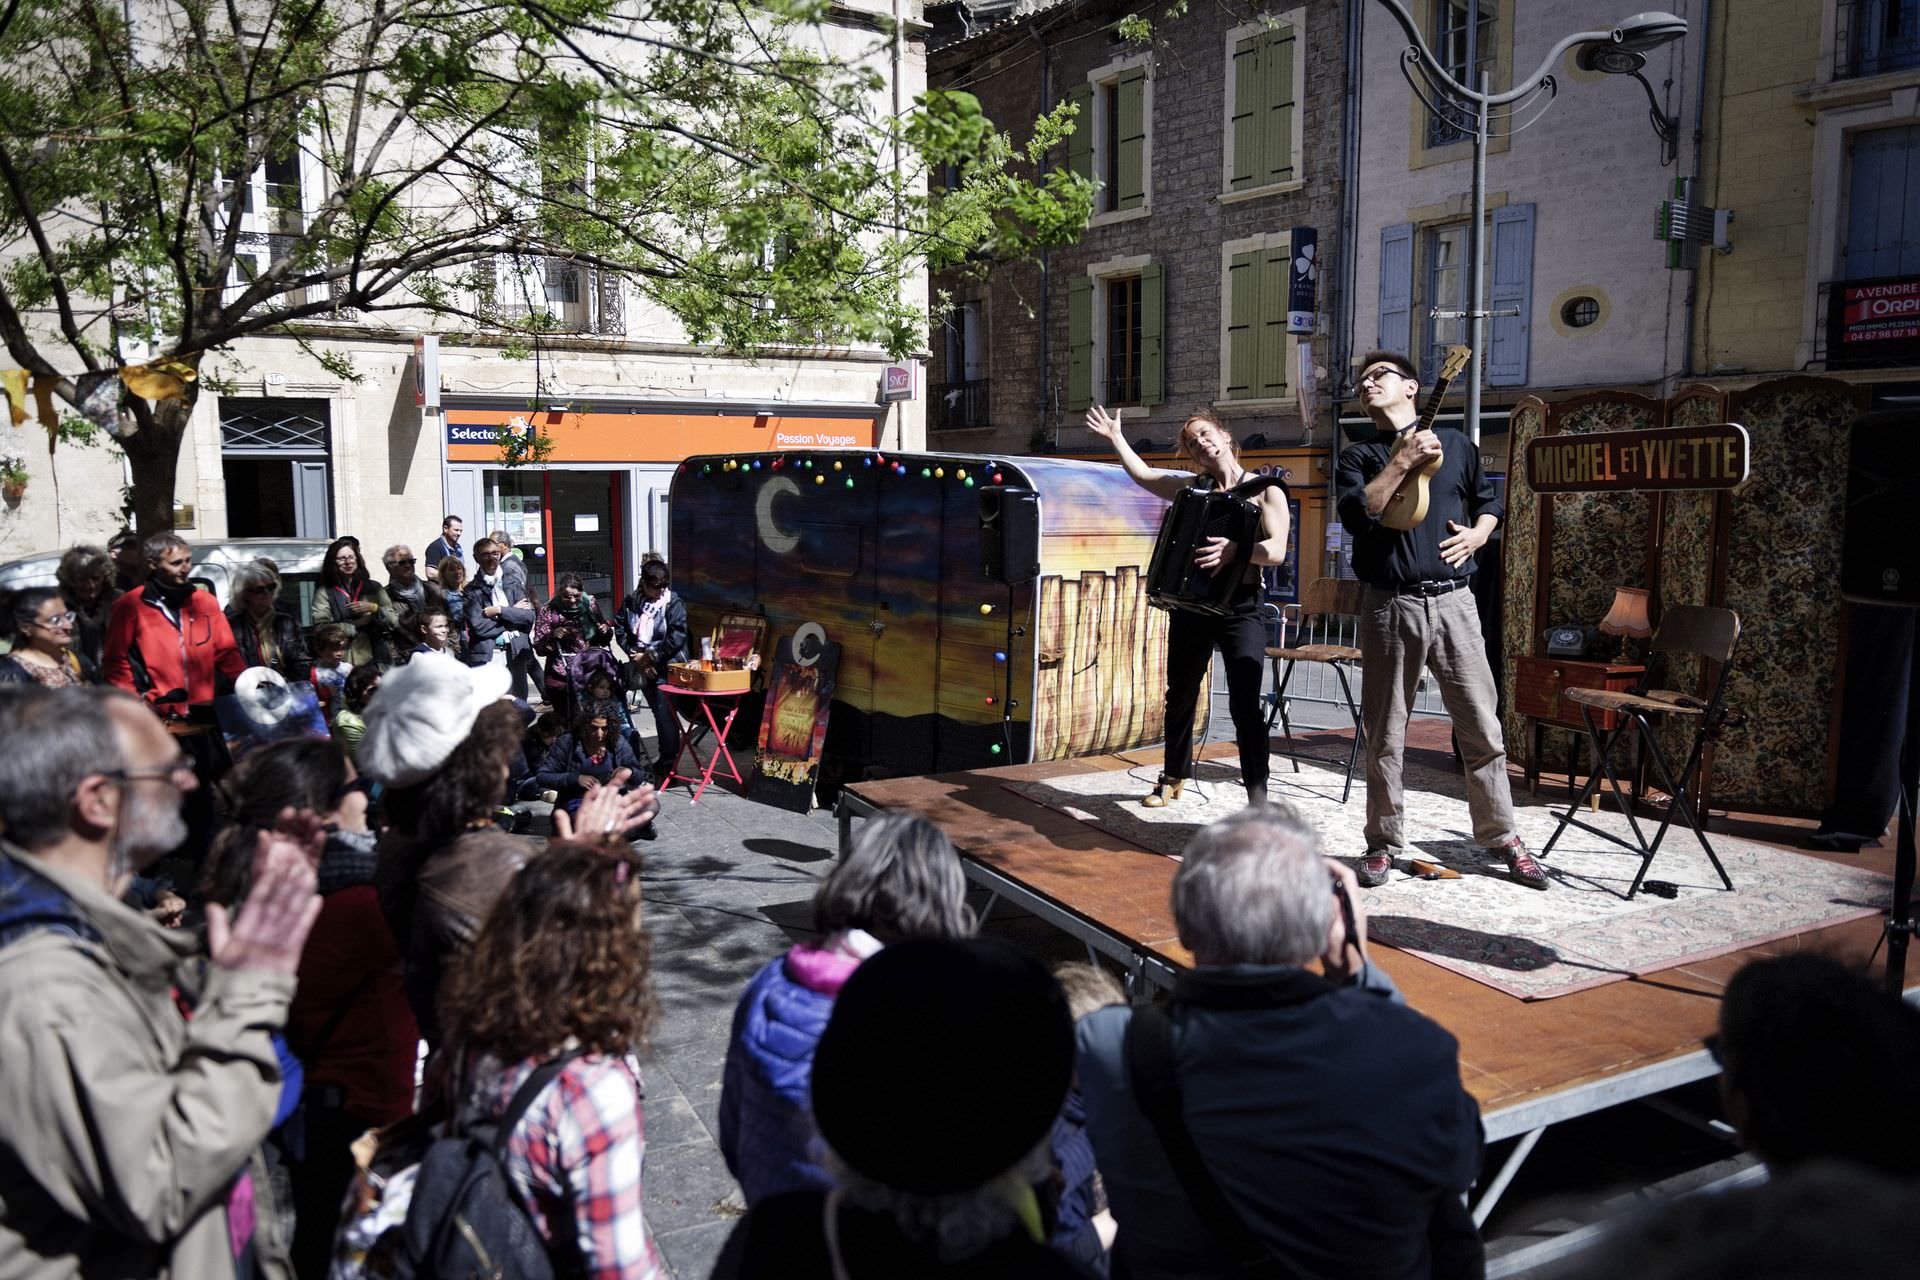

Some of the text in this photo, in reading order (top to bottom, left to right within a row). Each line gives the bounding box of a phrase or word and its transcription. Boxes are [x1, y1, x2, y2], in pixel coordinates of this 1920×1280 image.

[1856, 283, 1918, 299] A VENDRE
[1872, 299, 1920, 314] ORPI
[889, 373, 909, 387] SNCF
[777, 432, 857, 446] Passion Voyages
[1535, 436, 1737, 484] MICHEL ET YVETTE
